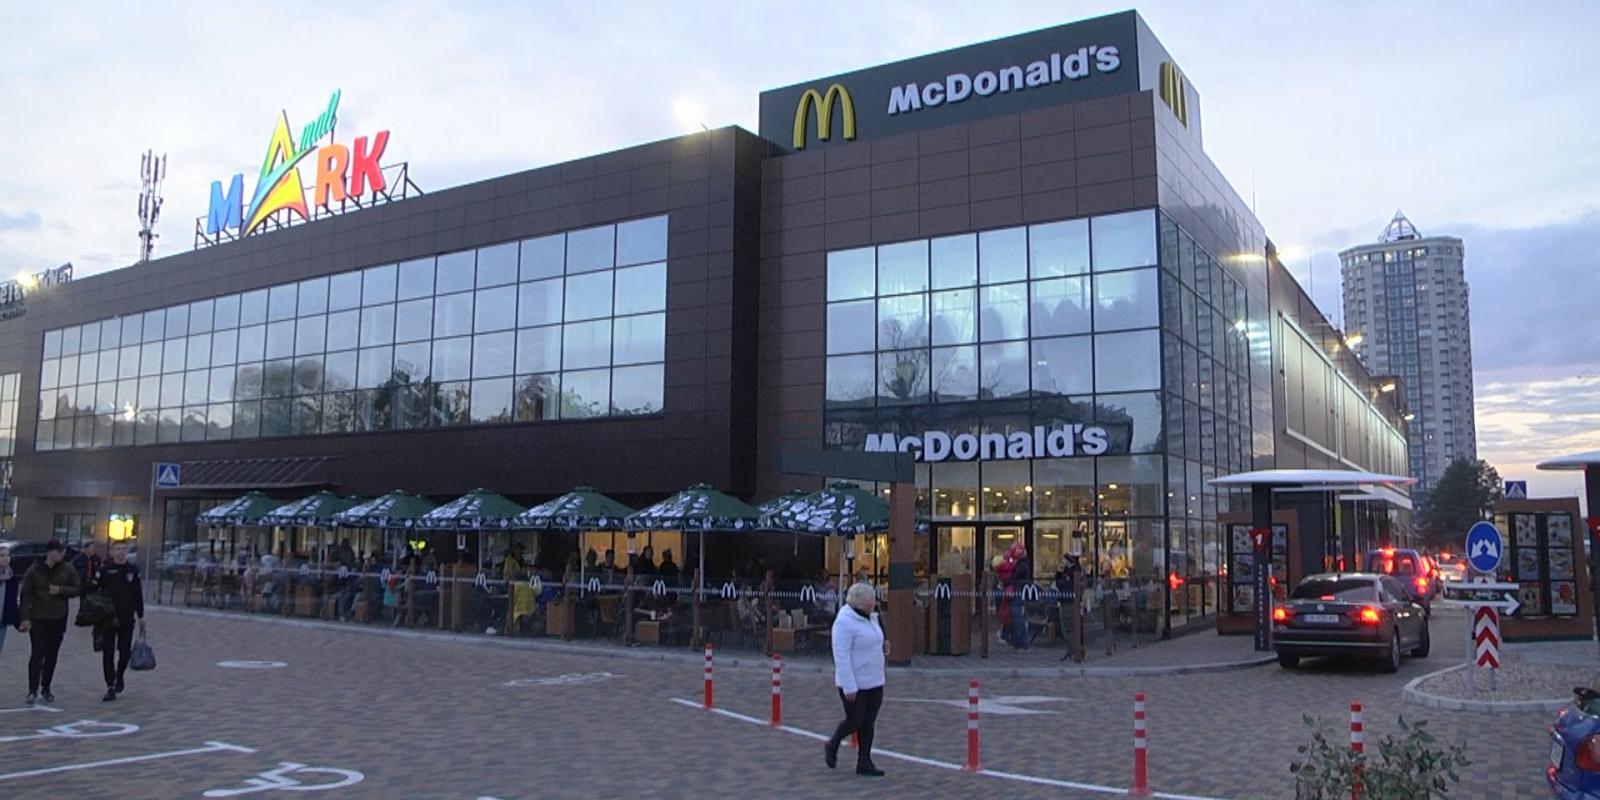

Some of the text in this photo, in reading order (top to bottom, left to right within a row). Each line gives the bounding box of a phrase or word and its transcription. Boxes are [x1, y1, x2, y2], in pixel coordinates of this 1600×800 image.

[888, 44, 1121, 116] McDonald's
[300, 89, 341, 151] mall
[207, 109, 389, 238] MARK
[864, 424, 1109, 462] McDonald's
